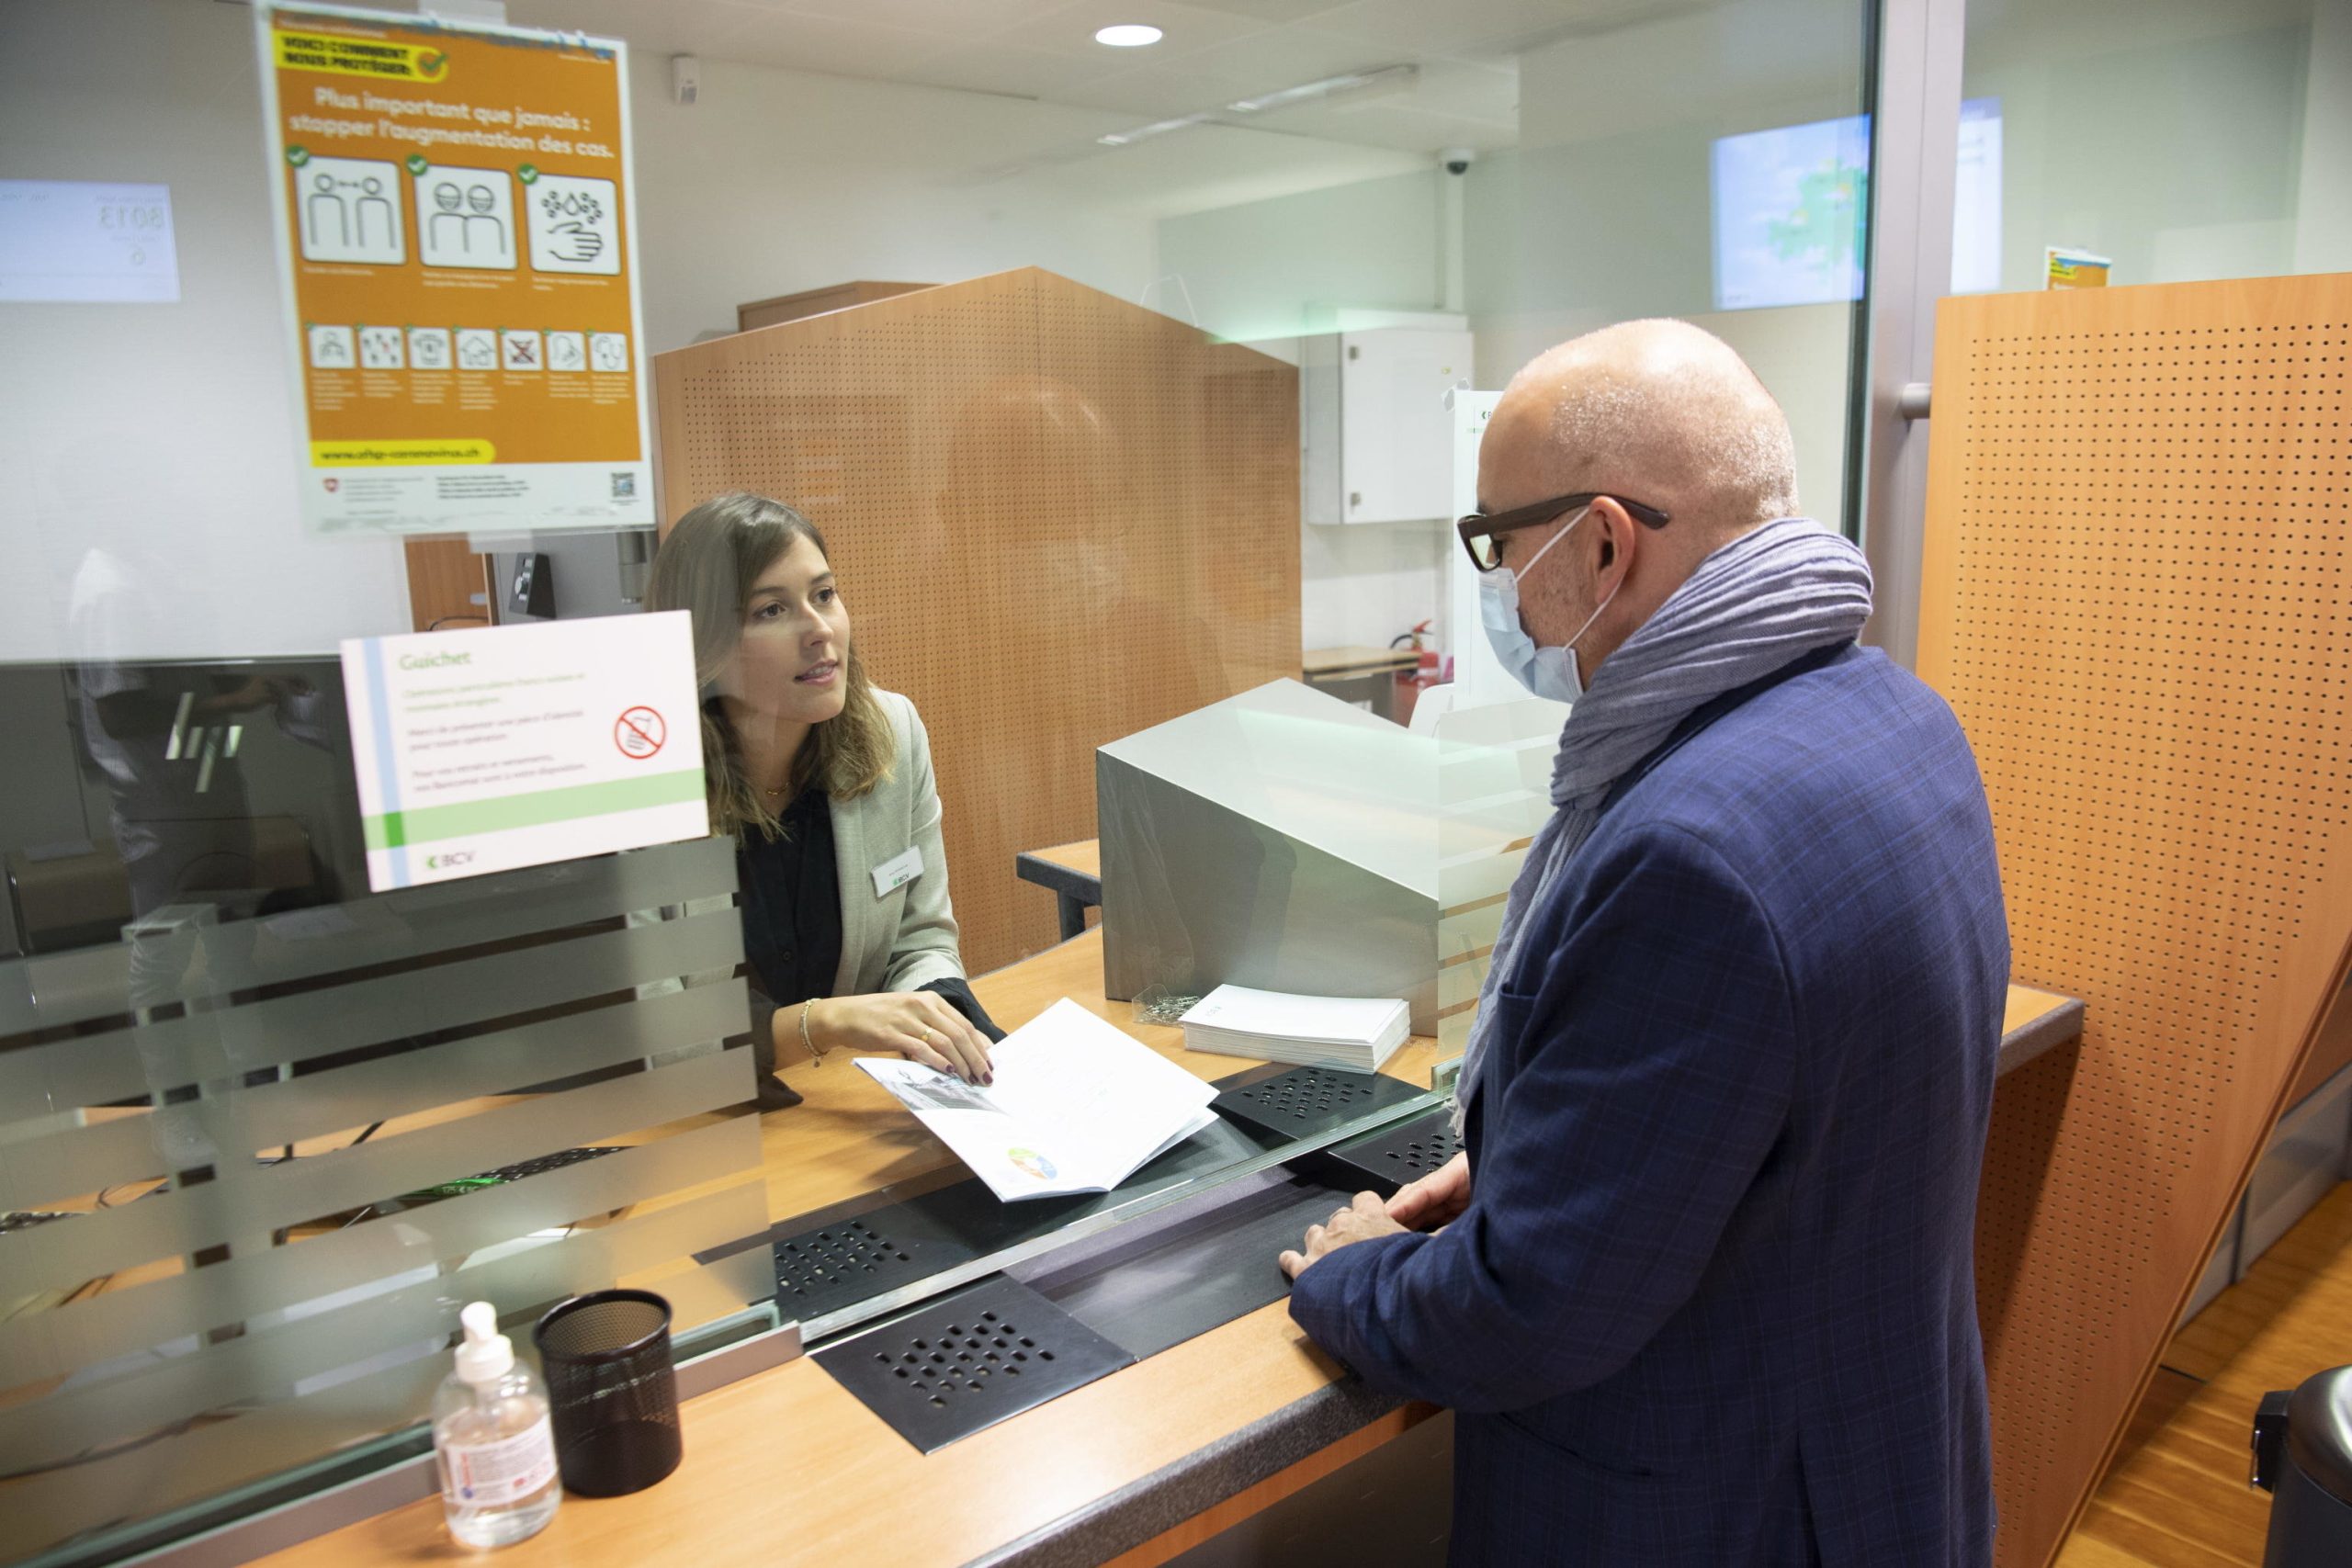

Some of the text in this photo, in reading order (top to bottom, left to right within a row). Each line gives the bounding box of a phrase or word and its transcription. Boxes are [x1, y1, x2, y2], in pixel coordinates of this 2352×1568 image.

[314, 86, 359, 109] Plus
[363, 90, 470, 120] important
[473, 107, 513, 126] que
[514, 106, 581, 130] jamais
[289, 115, 615, 158] stopper l'augmentation des cas.
[399, 650, 471, 671] Guichet
[441, 851, 477, 868] BCV
